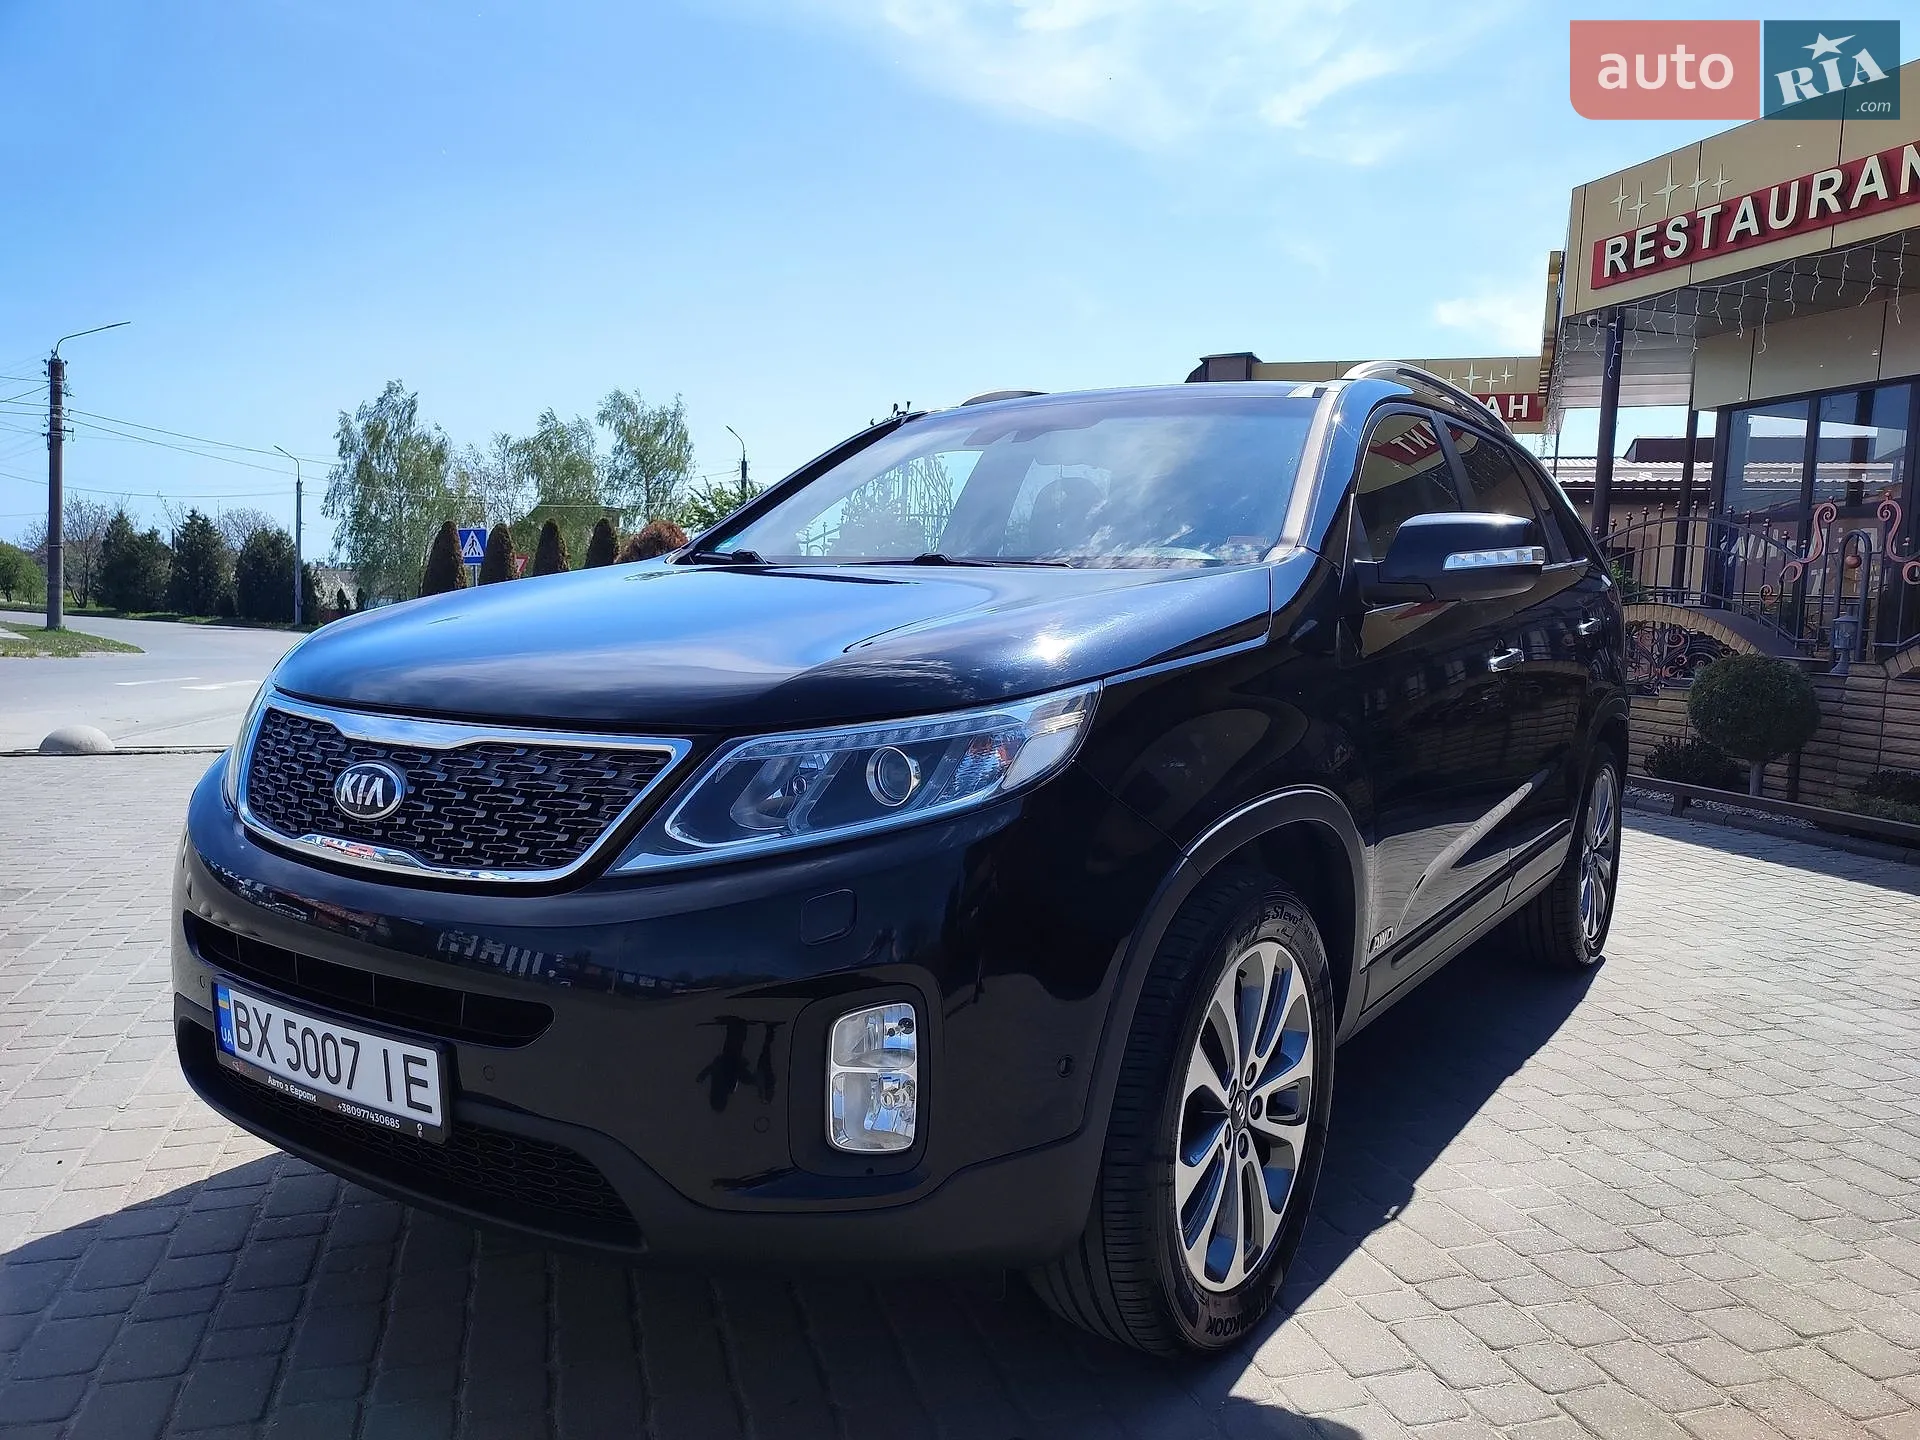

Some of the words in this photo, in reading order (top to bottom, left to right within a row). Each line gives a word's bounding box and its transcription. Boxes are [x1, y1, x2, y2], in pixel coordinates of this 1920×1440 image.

[340, 772, 385, 809] KIA
[221, 1025, 235, 1046] UA
[233, 999, 278, 1064] BX
[283, 1018, 360, 1091] 5007
[267, 1075, 284, 1090] Авто
[337, 1103, 400, 1129] +380977430685
